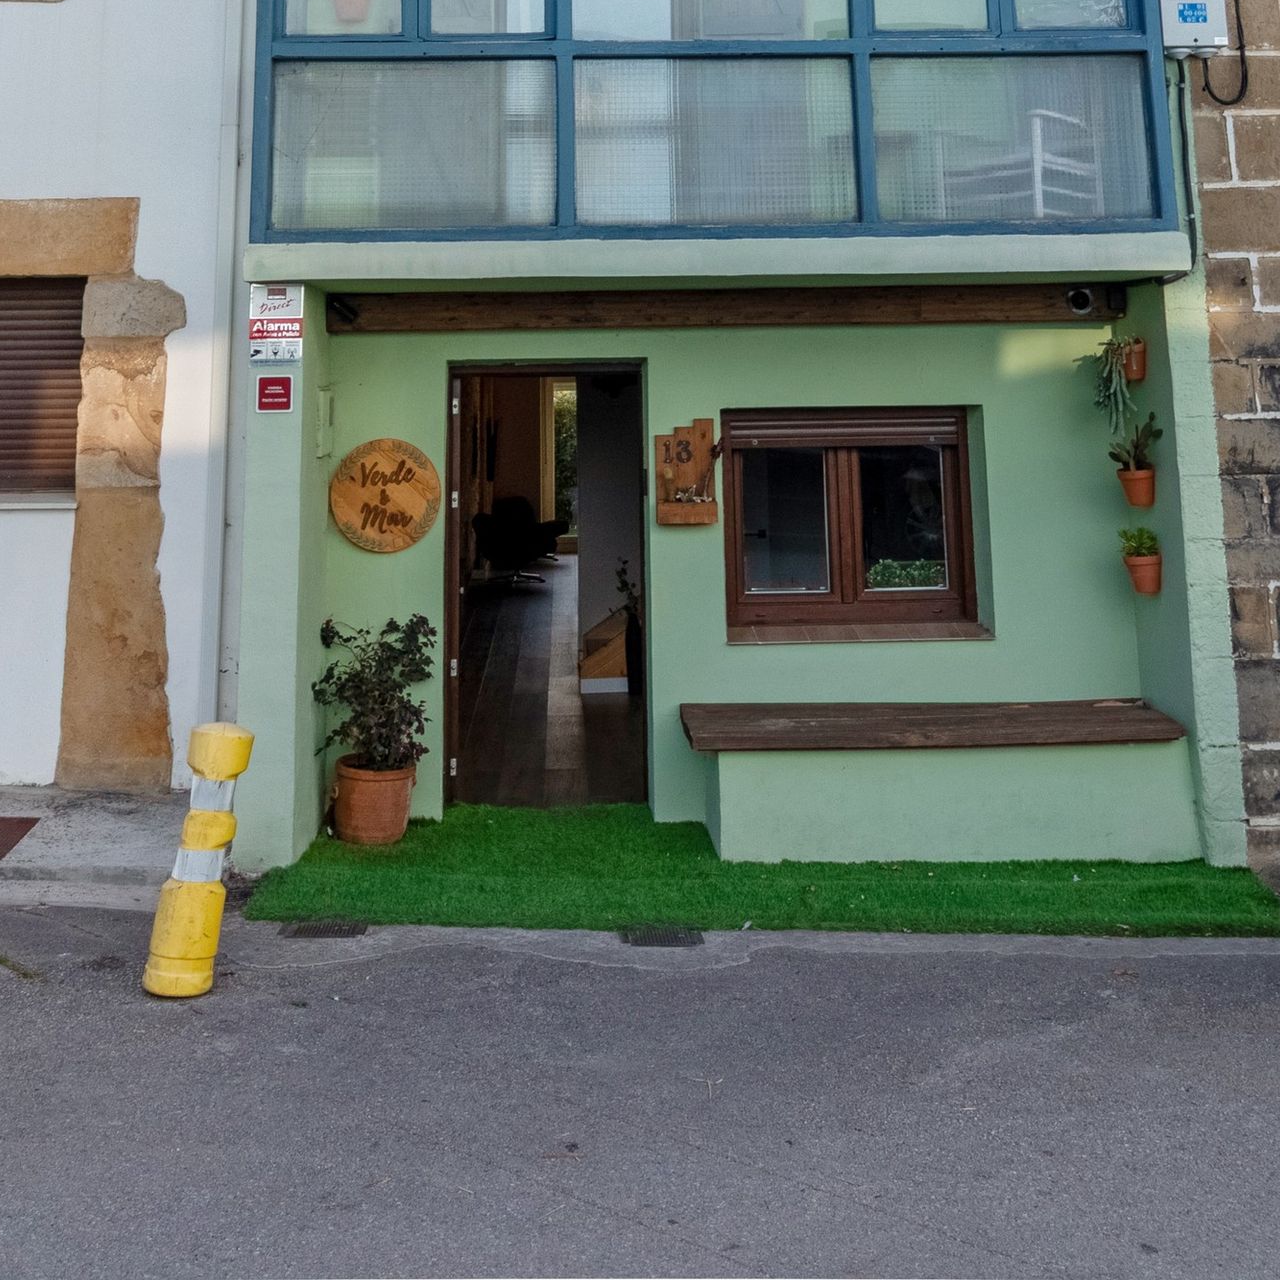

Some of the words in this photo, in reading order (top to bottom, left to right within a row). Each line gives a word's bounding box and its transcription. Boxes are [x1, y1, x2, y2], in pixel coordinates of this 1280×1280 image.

[259, 297, 296, 315] Direct
[252, 320, 300, 331] Alarma
[663, 439, 694, 464] 13
[360, 460, 416, 488] Verde
[360, 502, 414, 534] Mar
